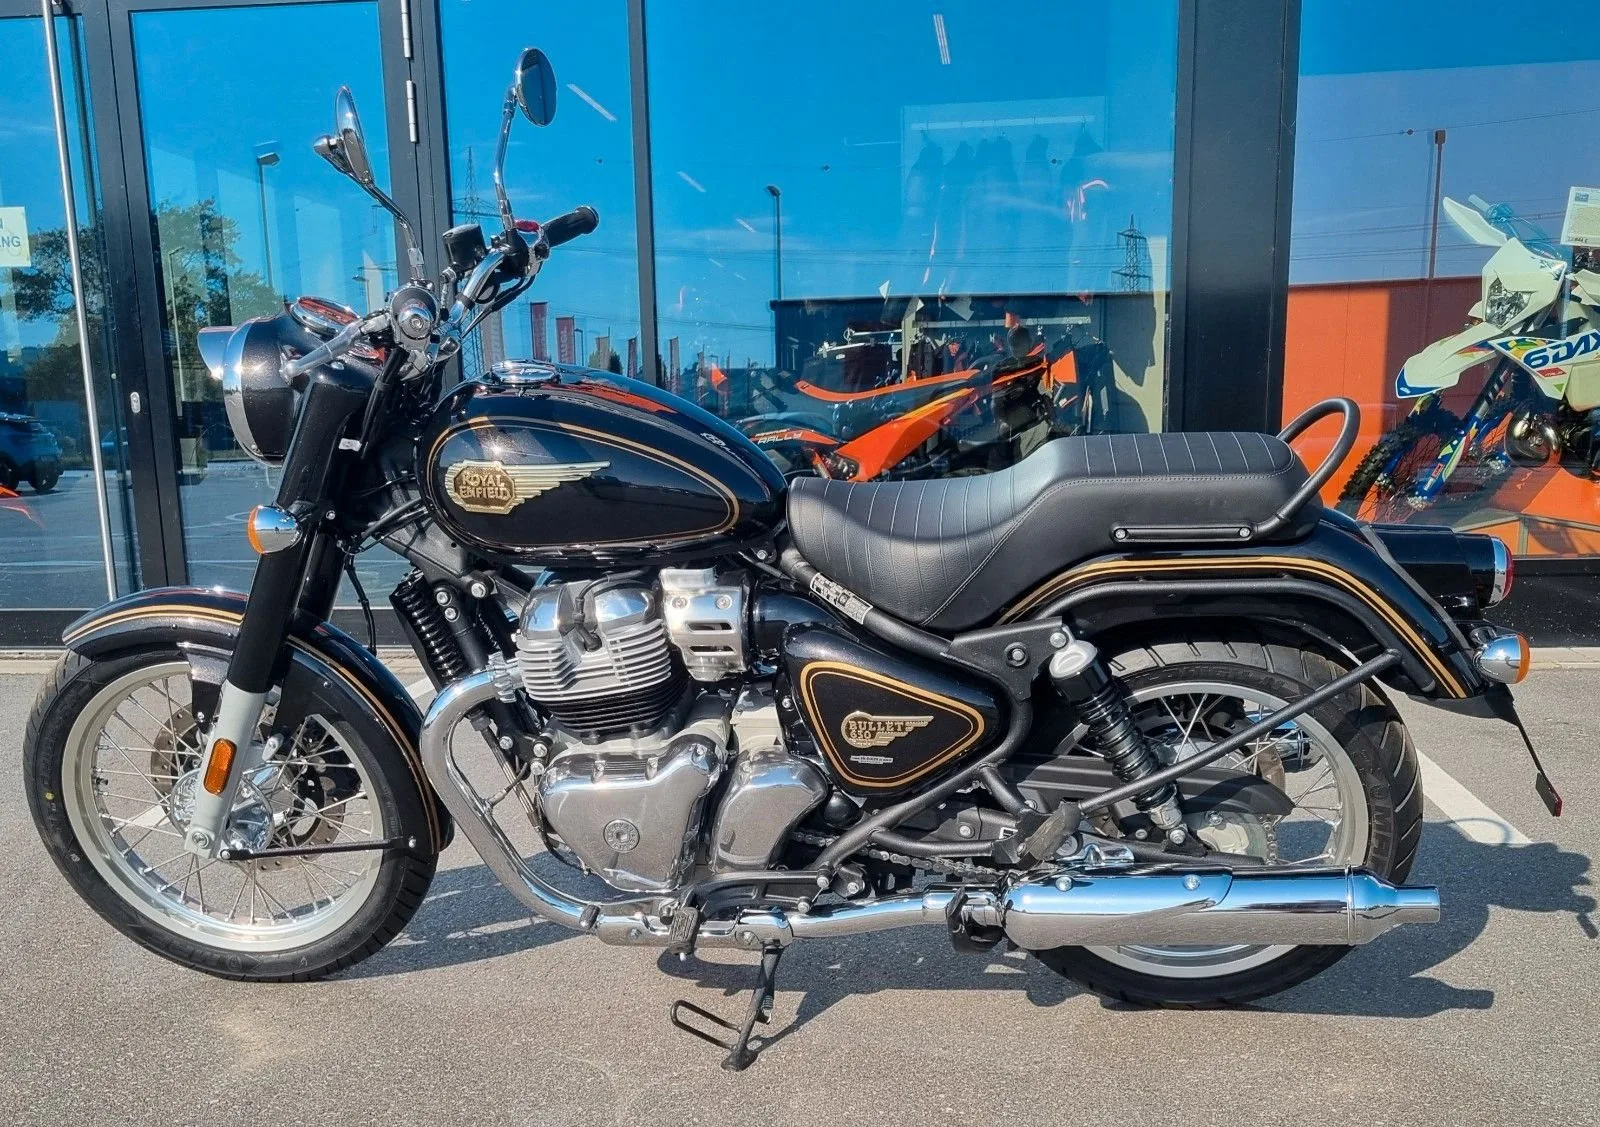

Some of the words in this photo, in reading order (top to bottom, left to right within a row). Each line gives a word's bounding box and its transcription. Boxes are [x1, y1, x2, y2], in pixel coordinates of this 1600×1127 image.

[0, 235, 21, 248] NG
[757, 431, 803, 445] RALLY
[461, 474, 505, 488] ROYAL
[459, 486, 512, 500] ENFIELD
[848, 720, 904, 732] BULLET
[849, 731, 872, 740] 650
